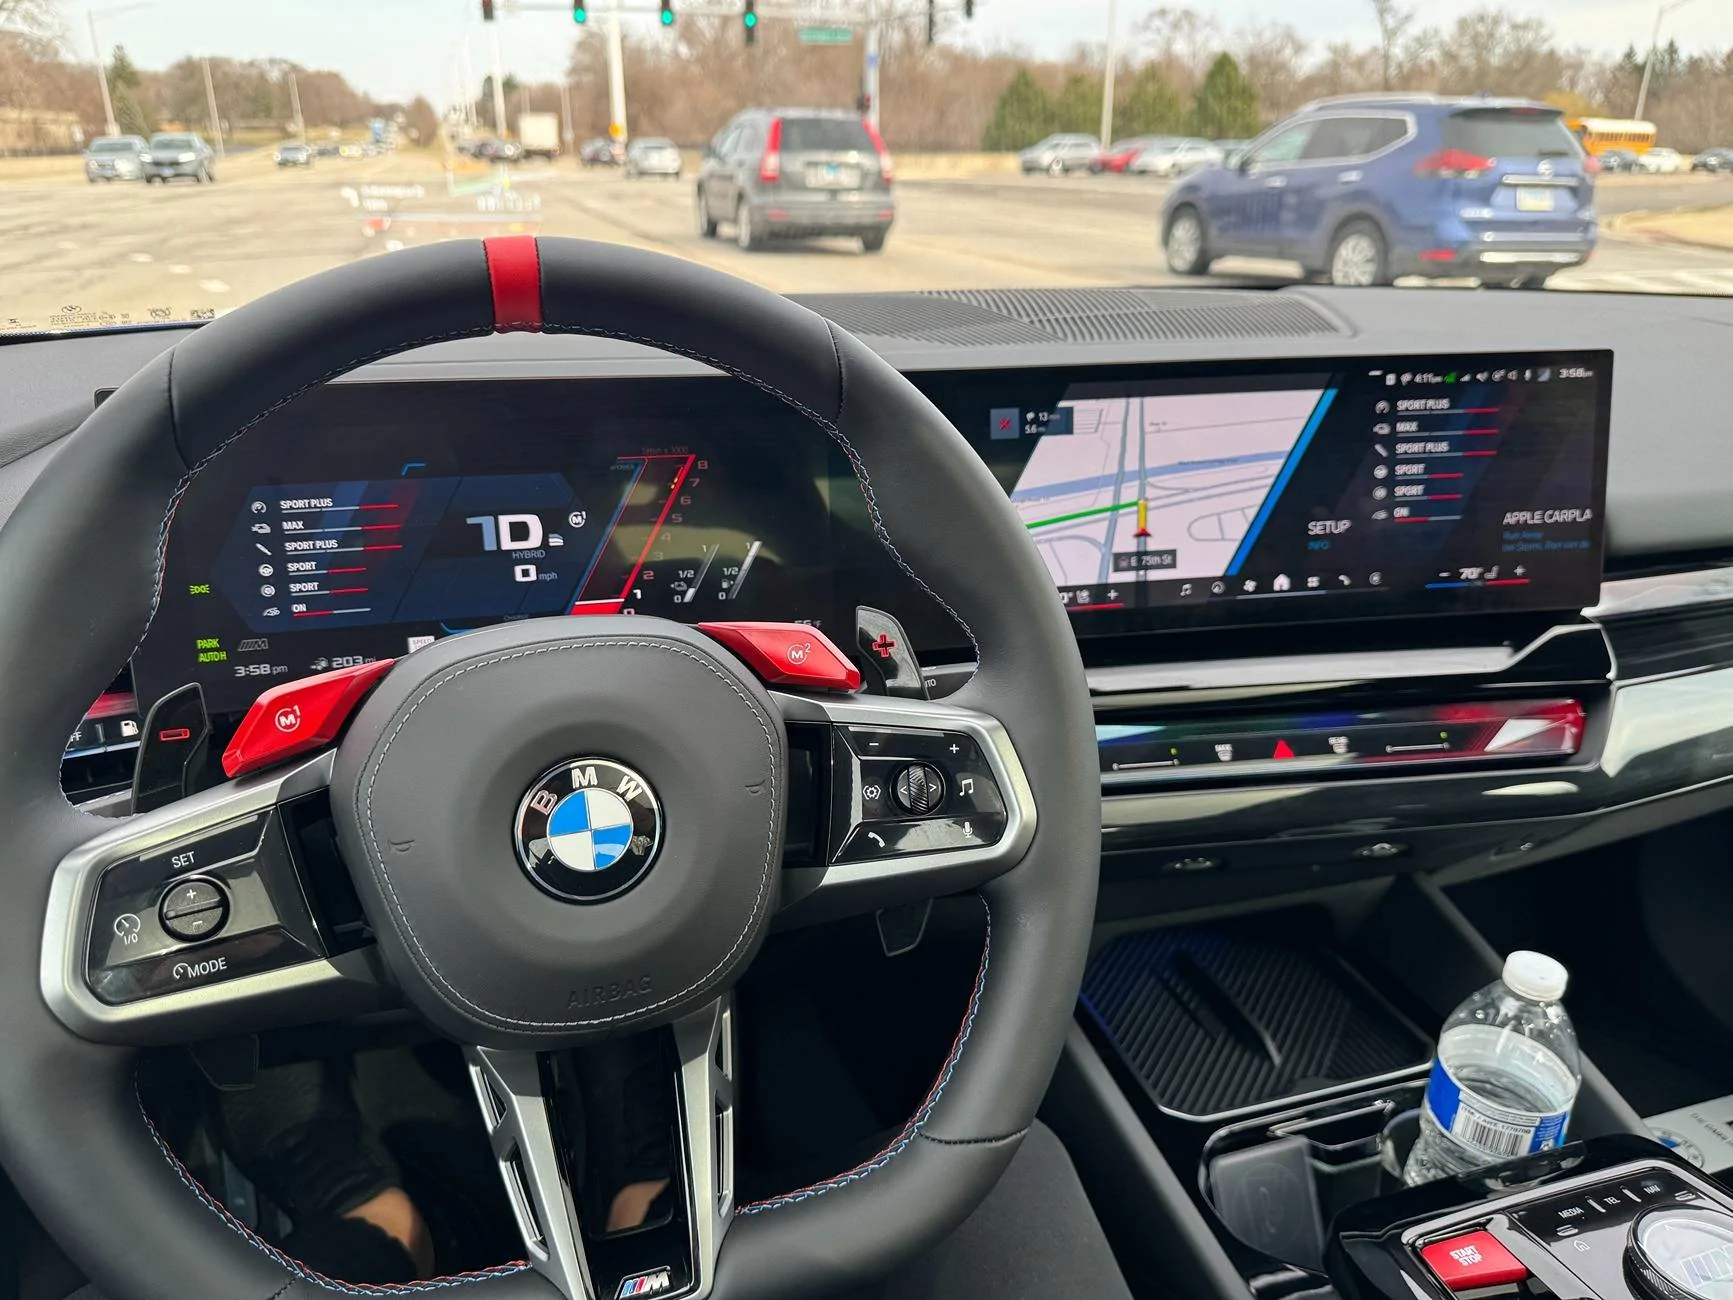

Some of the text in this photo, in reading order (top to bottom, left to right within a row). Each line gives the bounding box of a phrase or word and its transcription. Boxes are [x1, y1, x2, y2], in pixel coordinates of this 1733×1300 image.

[1559, 367, 1583, 378] 3:58
[1396, 398, 1451, 411] SPORT PLUS
[1395, 421, 1419, 432] MAX
[1395, 441, 1450, 454] SPORT PLUS
[697, 460, 708, 470] 8
[1394, 464, 1425, 475] SPORT
[689, 478, 700, 488] 7
[1394, 485, 1425, 496] SPORT
[280, 498, 333, 509] SPORT PLUS
[680, 496, 692, 505] 6
[671, 513, 683, 523] 5
[1502, 510, 1544, 525] APPLE
[282, 521, 304, 530] MAX
[1307, 519, 1352, 535] SETUP
[661, 532, 672, 542] 4
[284, 539, 338, 551] SPORT PLUS
[512, 550, 546, 559] HYBRID
[1140, 555, 1161, 566] 75th
[287, 562, 317, 572] SPORT
[723, 567, 739, 576] 1/2
[514, 564, 558, 582] 0 mph
[643, 571, 654, 580] 2
[678, 570, 695, 578] 1/2
[289, 582, 319, 592] SPORT
[632, 589, 642, 599] 1
[291, 604, 307, 612] ON
[196, 638, 220, 649] PARK
[332, 655, 363, 668] 203
[234, 664, 288, 677] 3:58 pm
[530, 766, 643, 815] BMW
[171, 851, 195, 868] SET
[187, 956, 228, 979] MODE
[567, 975, 652, 1010] AIRBAG
[1643, 1184, 1662, 1195] NAV
[1604, 1196, 1622, 1206] TEL
[1558, 1206, 1585, 1219] MEDIA
[1449, 1244, 1478, 1260] START
[1459, 1253, 1483, 1266] STOP
